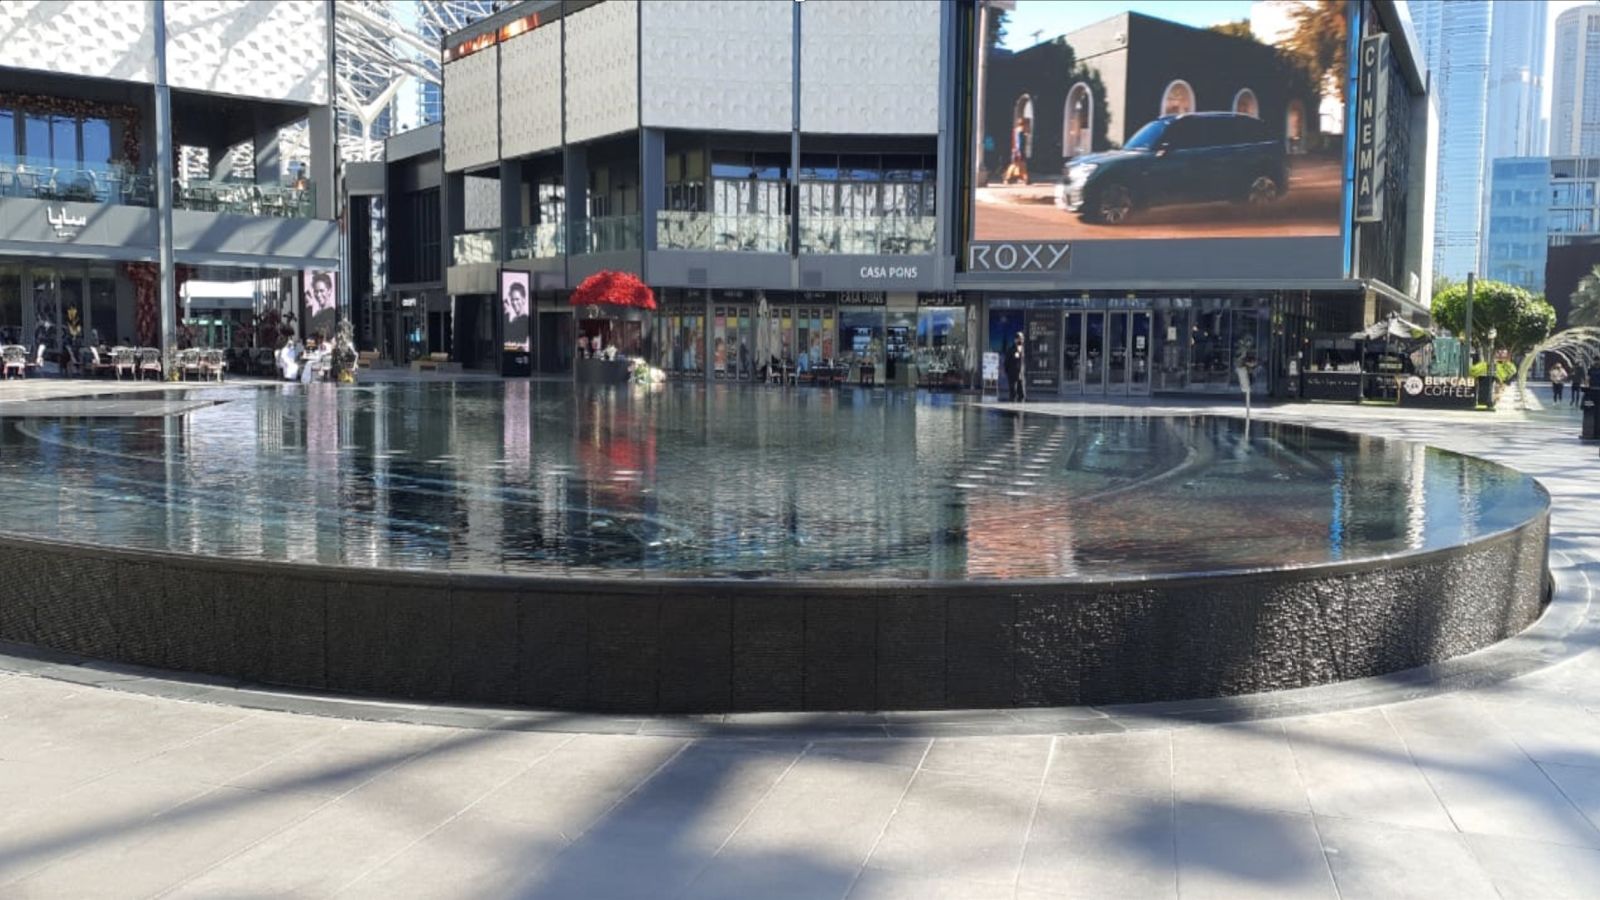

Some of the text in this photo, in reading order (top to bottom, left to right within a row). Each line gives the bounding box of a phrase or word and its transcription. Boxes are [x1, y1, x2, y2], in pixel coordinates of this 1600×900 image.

[1359, 46, 1375, 194] CINEMA
[969, 244, 1070, 270] ROXY
[860, 266, 918, 279] CASA PONS
